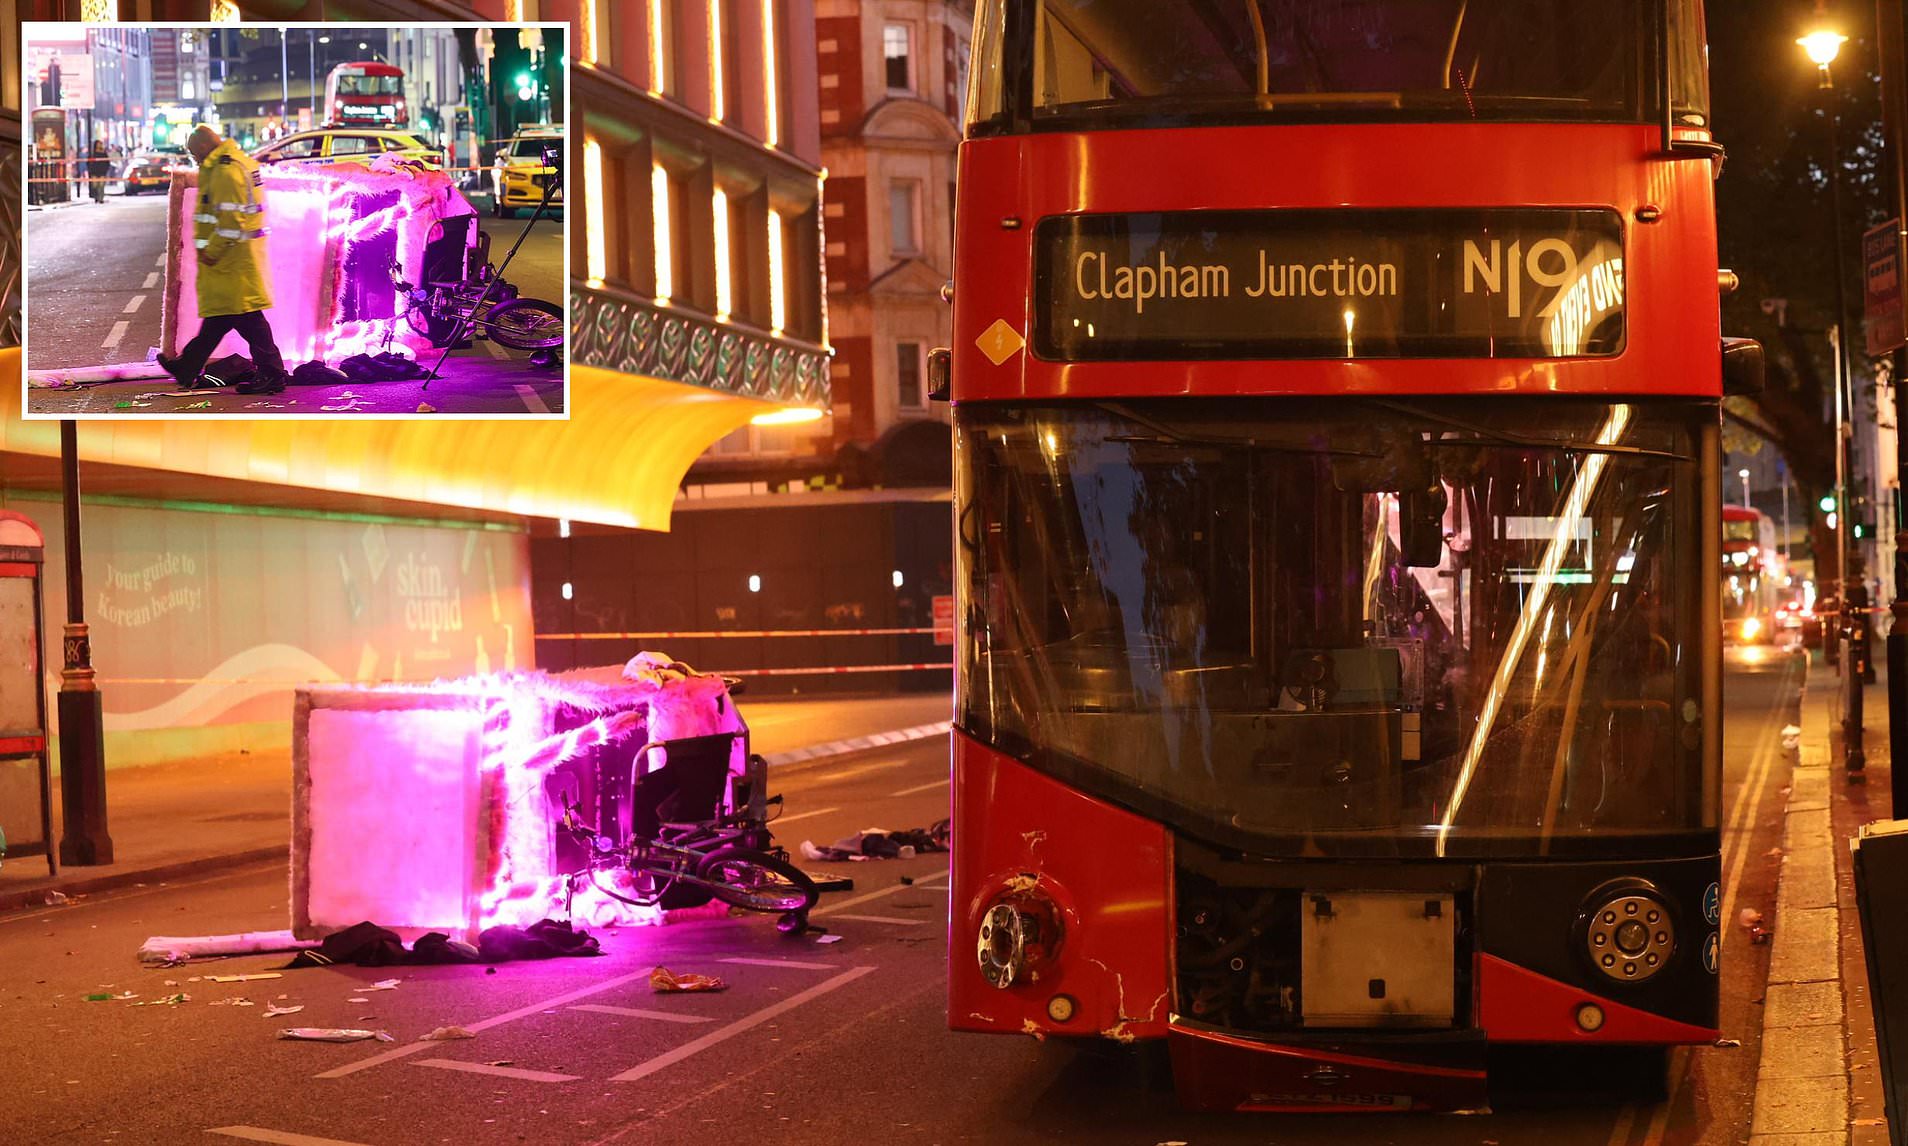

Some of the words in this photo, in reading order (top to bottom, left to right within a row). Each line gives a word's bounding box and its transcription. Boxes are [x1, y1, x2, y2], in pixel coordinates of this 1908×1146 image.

[1075, 250, 1230, 314] Clapham
[1245, 249, 1397, 298] Junction
[1463, 237, 1578, 318] N19
[143, 551, 181, 593] guide
[182, 553, 196, 576] to
[97, 592, 151, 627] Korean
[151, 586, 202, 613] beauty!
[405, 585, 463, 643] cupid
